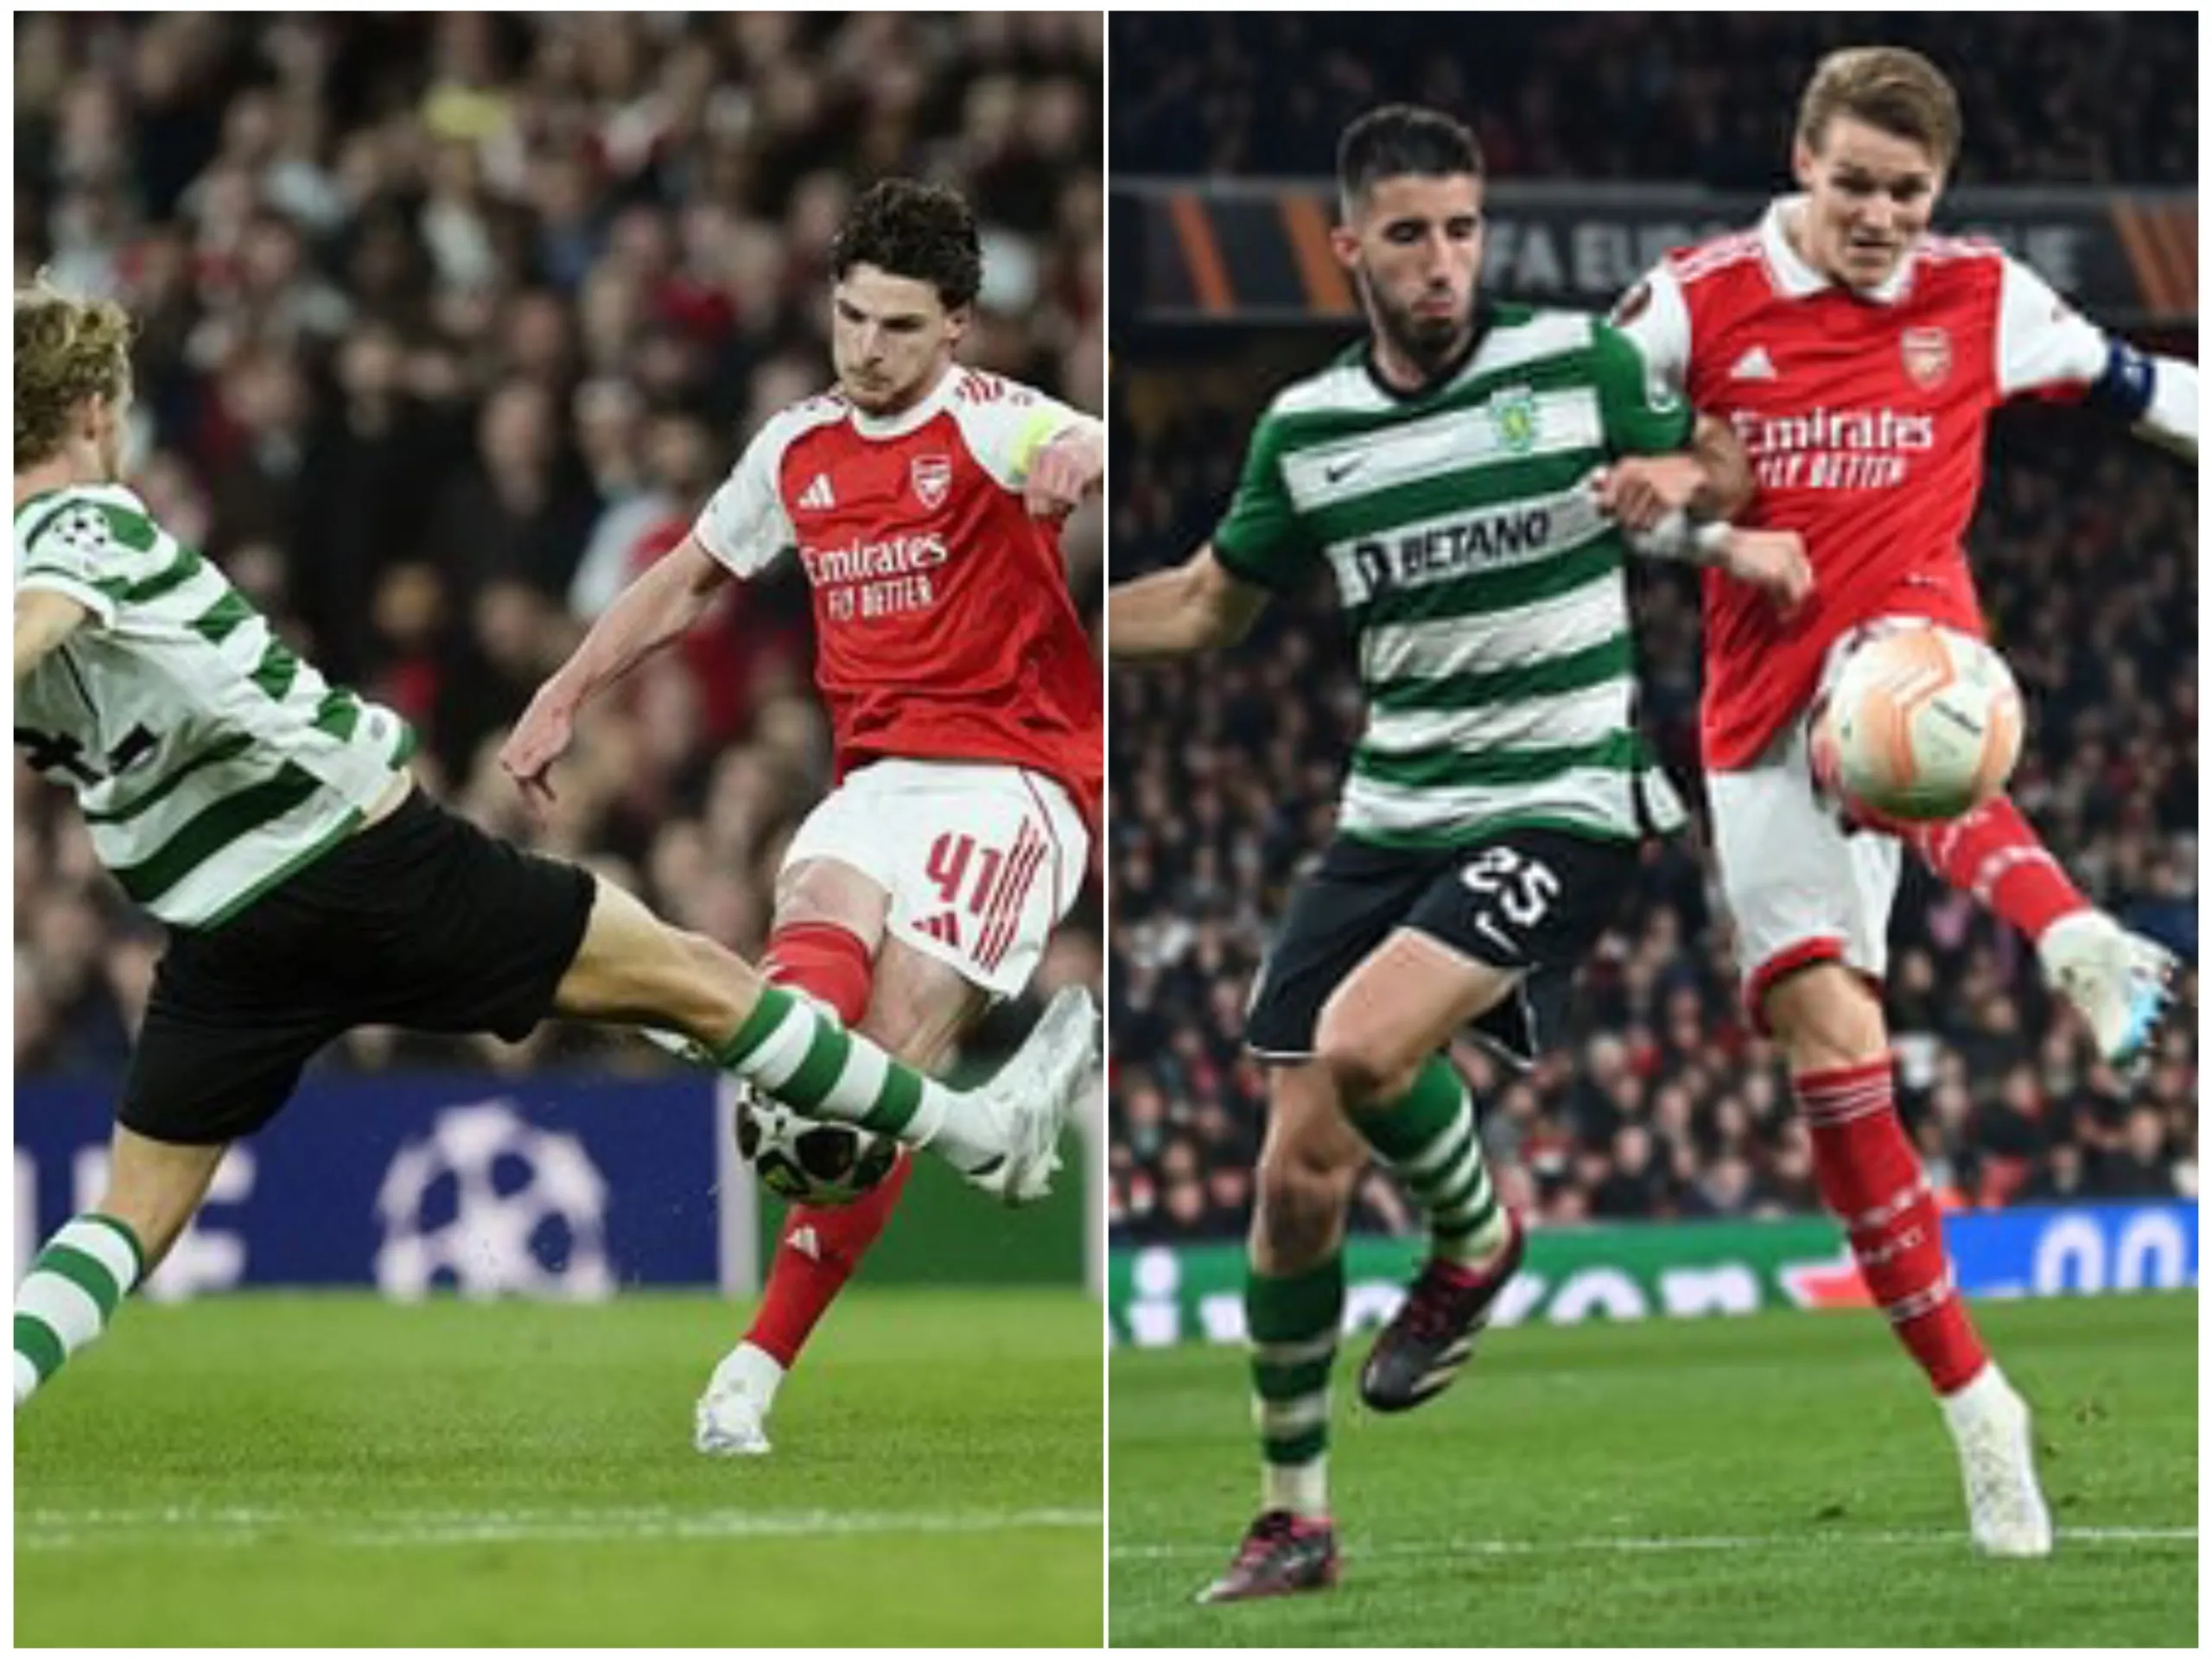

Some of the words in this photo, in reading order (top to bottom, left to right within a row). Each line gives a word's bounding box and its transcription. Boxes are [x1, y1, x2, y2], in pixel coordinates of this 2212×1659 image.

[1730, 406, 1933, 454] Emirates
[799, 532, 948, 588] Emirates
[1400, 508, 1552, 577] BETANO
[925, 832, 1003, 917] 41
[1459, 844, 1560, 929] 25
